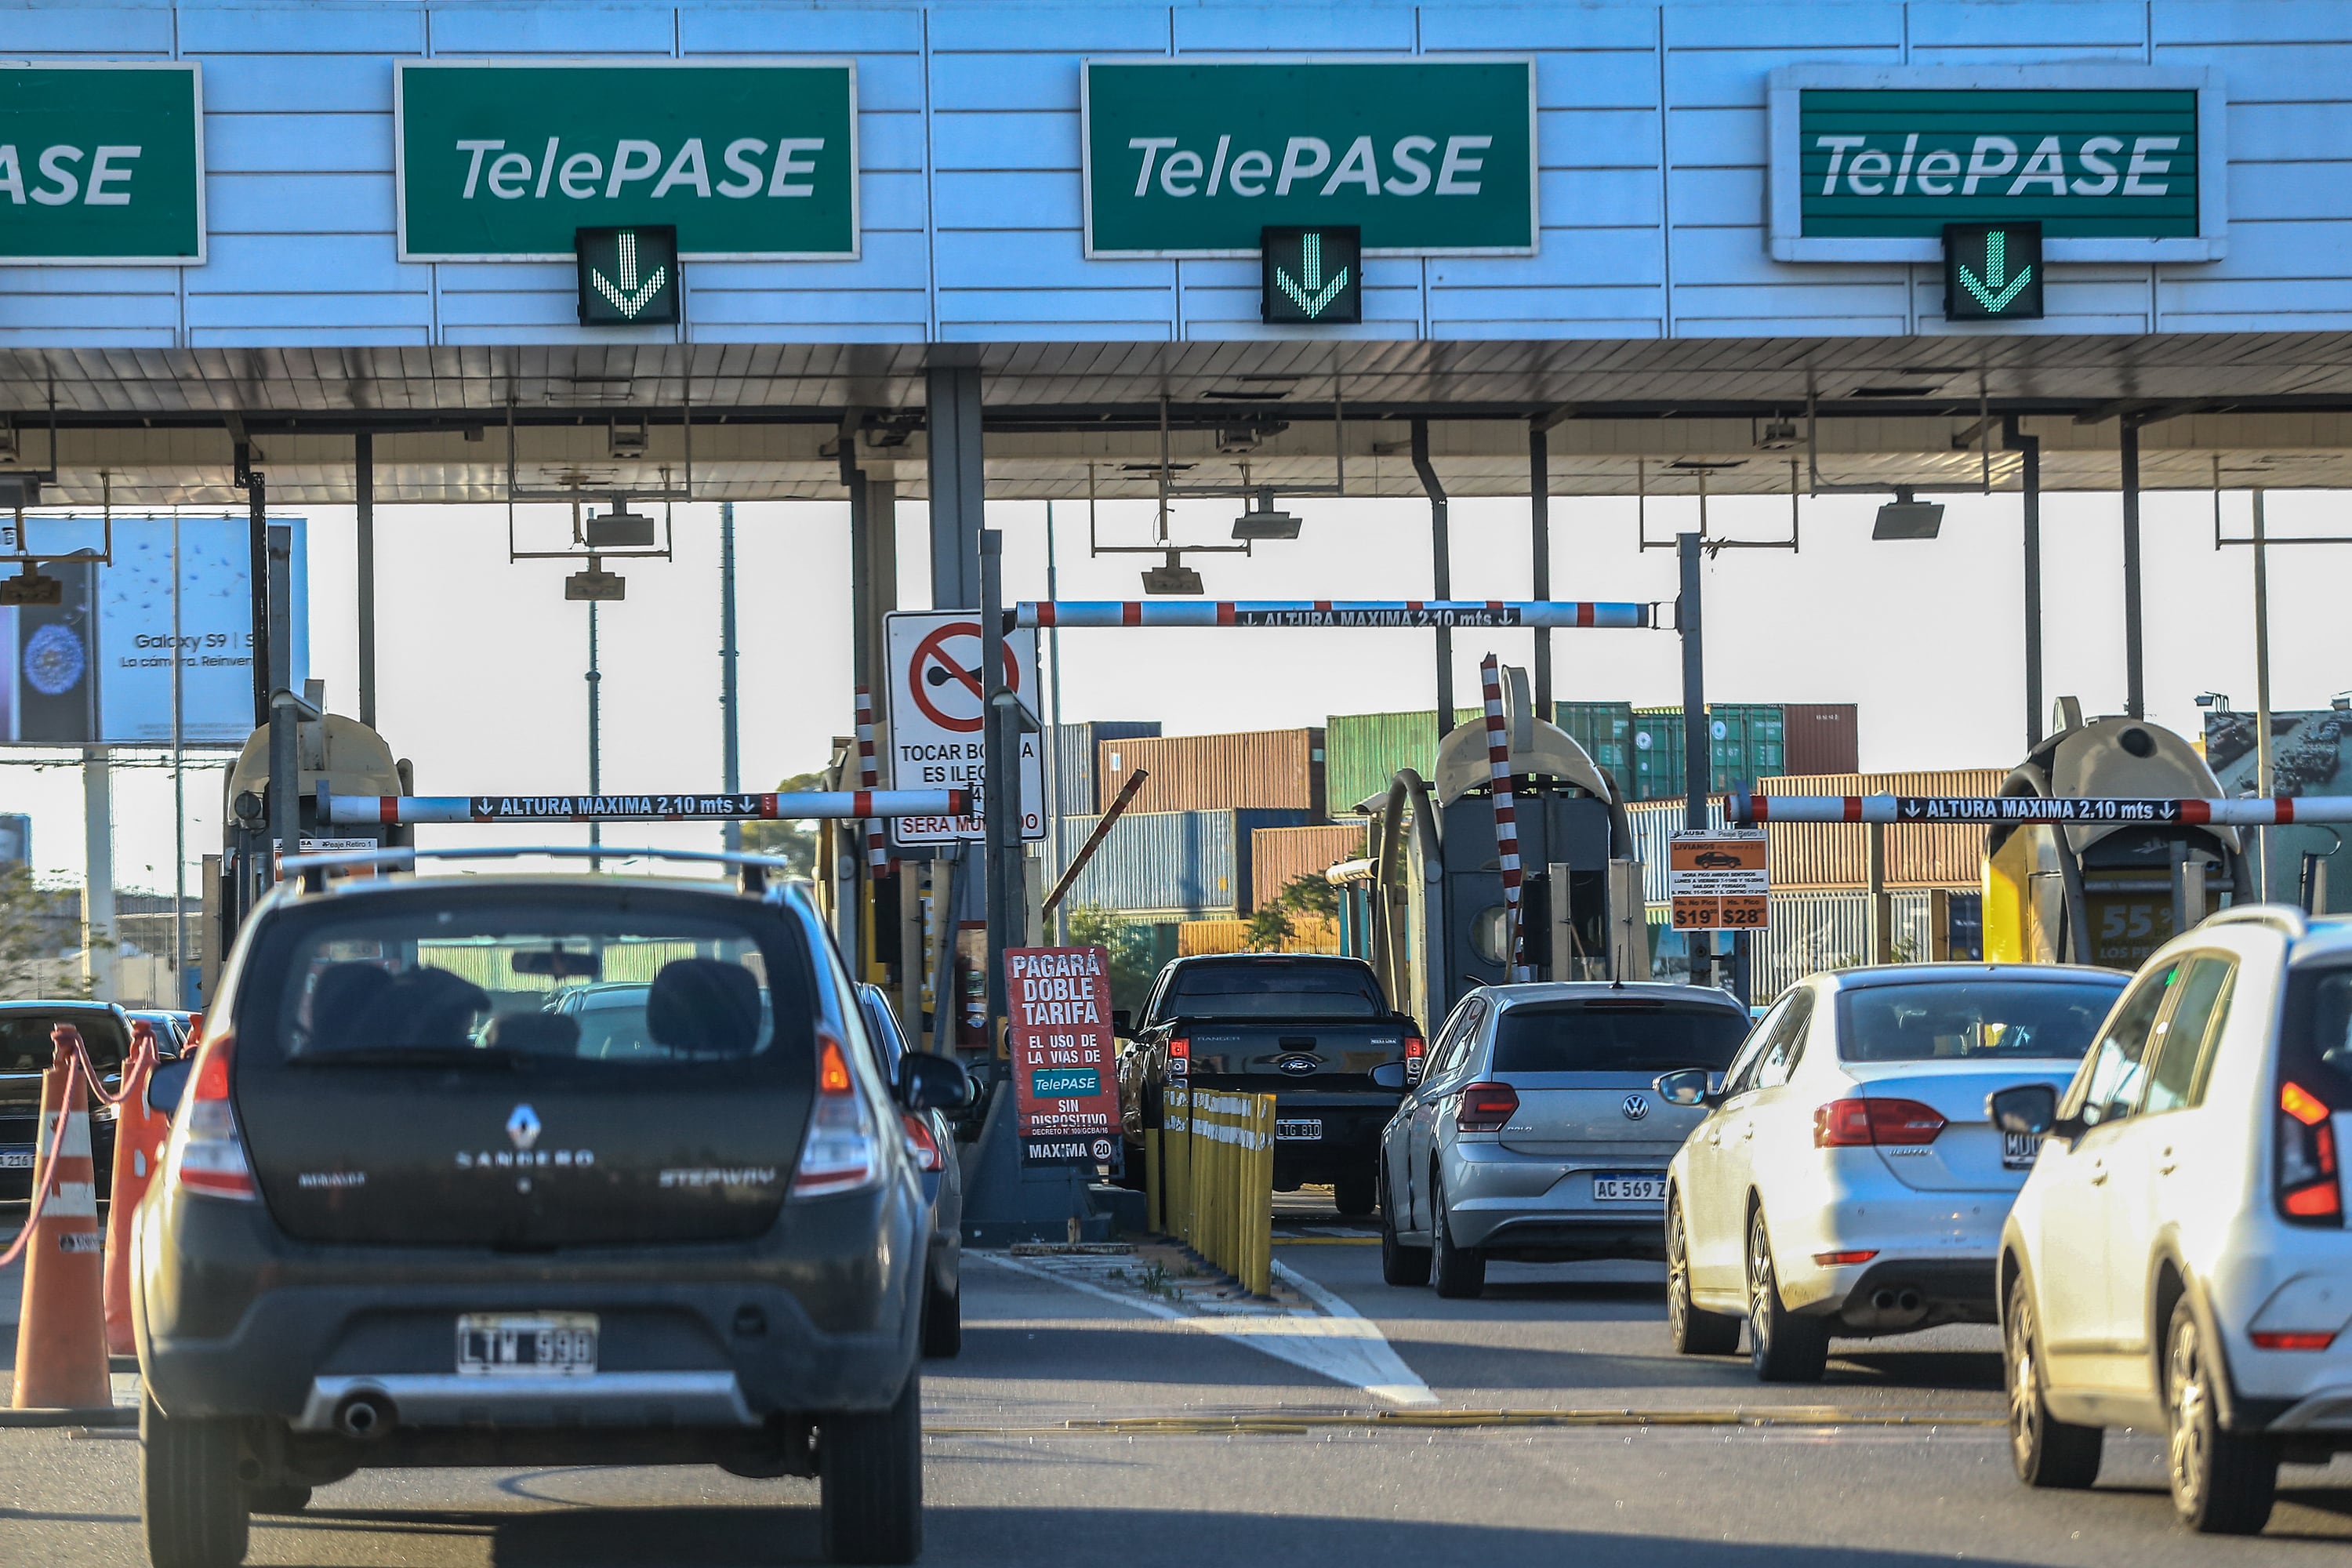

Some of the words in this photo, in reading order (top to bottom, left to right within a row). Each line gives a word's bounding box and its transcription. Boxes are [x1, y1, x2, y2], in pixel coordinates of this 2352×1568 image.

[456, 136, 825, 199] TelePASE
[1127, 134, 1493, 198] TelePASE
[1816, 132, 2181, 195] TelePASE
[0, 144, 142, 206] ASE
[1265, 611, 1334, 626] ALTURA
[1341, 610, 1411, 626] MAXIMA
[1417, 609, 1455, 626] 2.10
[1459, 609, 1492, 625] mts
[135, 633, 201, 652] Galaxy
[206, 633, 227, 648] S9
[121, 656, 137, 667] La
[141, 655, 198, 667] cámra.
[901, 744, 961, 761] TOCAR
[924, 766, 945, 782] ES
[499, 798, 572, 815] ALTURA
[578, 797, 652, 815] MAXIMA
[657, 797, 695, 814] 2.10
[700, 797, 734, 814] mts
[1926, 800, 1998, 818] ALTURA
[2002, 800, 2074, 818] MAXIMA
[2079, 801, 2115, 819] 2.10
[2121, 802, 2154, 819] mts
[903, 817, 951, 833] SERA
[1675, 909, 1710, 926] $19
[1723, 909, 1758, 925] $28
[2100, 905, 2153, 939] 55
[2100, 947, 2128, 959] LOS
[1012, 948, 1101, 978] PAGARÁ
[1023, 978, 1094, 1002] DOBLE
[1022, 1001, 1100, 1025] TARIFA
[1029, 1036, 1044, 1048] EL
[1050, 1034, 1074, 1047] USO
[1081, 1034, 1098, 1047] DE
[1028, 1051, 1044, 1064] LA
[1051, 1051, 1079, 1064] VIAS
[1084, 1050, 1102, 1063] DE
[1036, 1077, 1096, 1091] TelePASE
[1058, 1099, 1080, 1112] SIN
[1031, 1113, 1107, 1127] DISPOSITIVO
[1278, 1125, 1296, 1136] LTG
[1301, 1124, 1320, 1136] 810
[1095, 1144, 1109, 1155] 20
[1598, 1182, 1617, 1197] AC
[1622, 1182, 1652, 1197] 569
